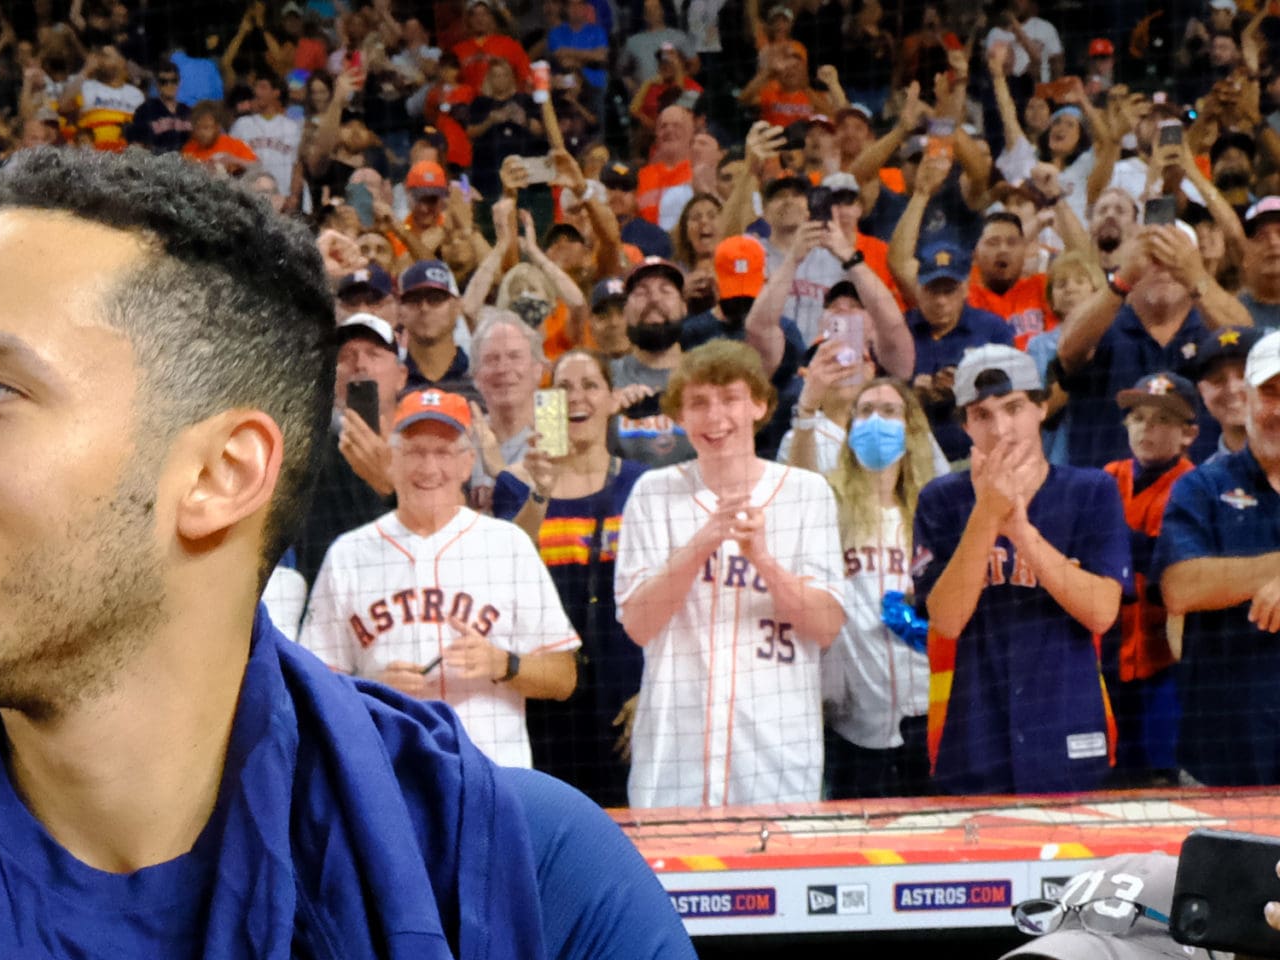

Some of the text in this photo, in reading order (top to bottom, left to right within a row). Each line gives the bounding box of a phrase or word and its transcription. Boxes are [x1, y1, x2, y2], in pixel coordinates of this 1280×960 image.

[349, 588, 500, 648] ASTROS
[756, 618, 796, 664] 35
[900, 885, 1006, 907] ASTROS.COM
